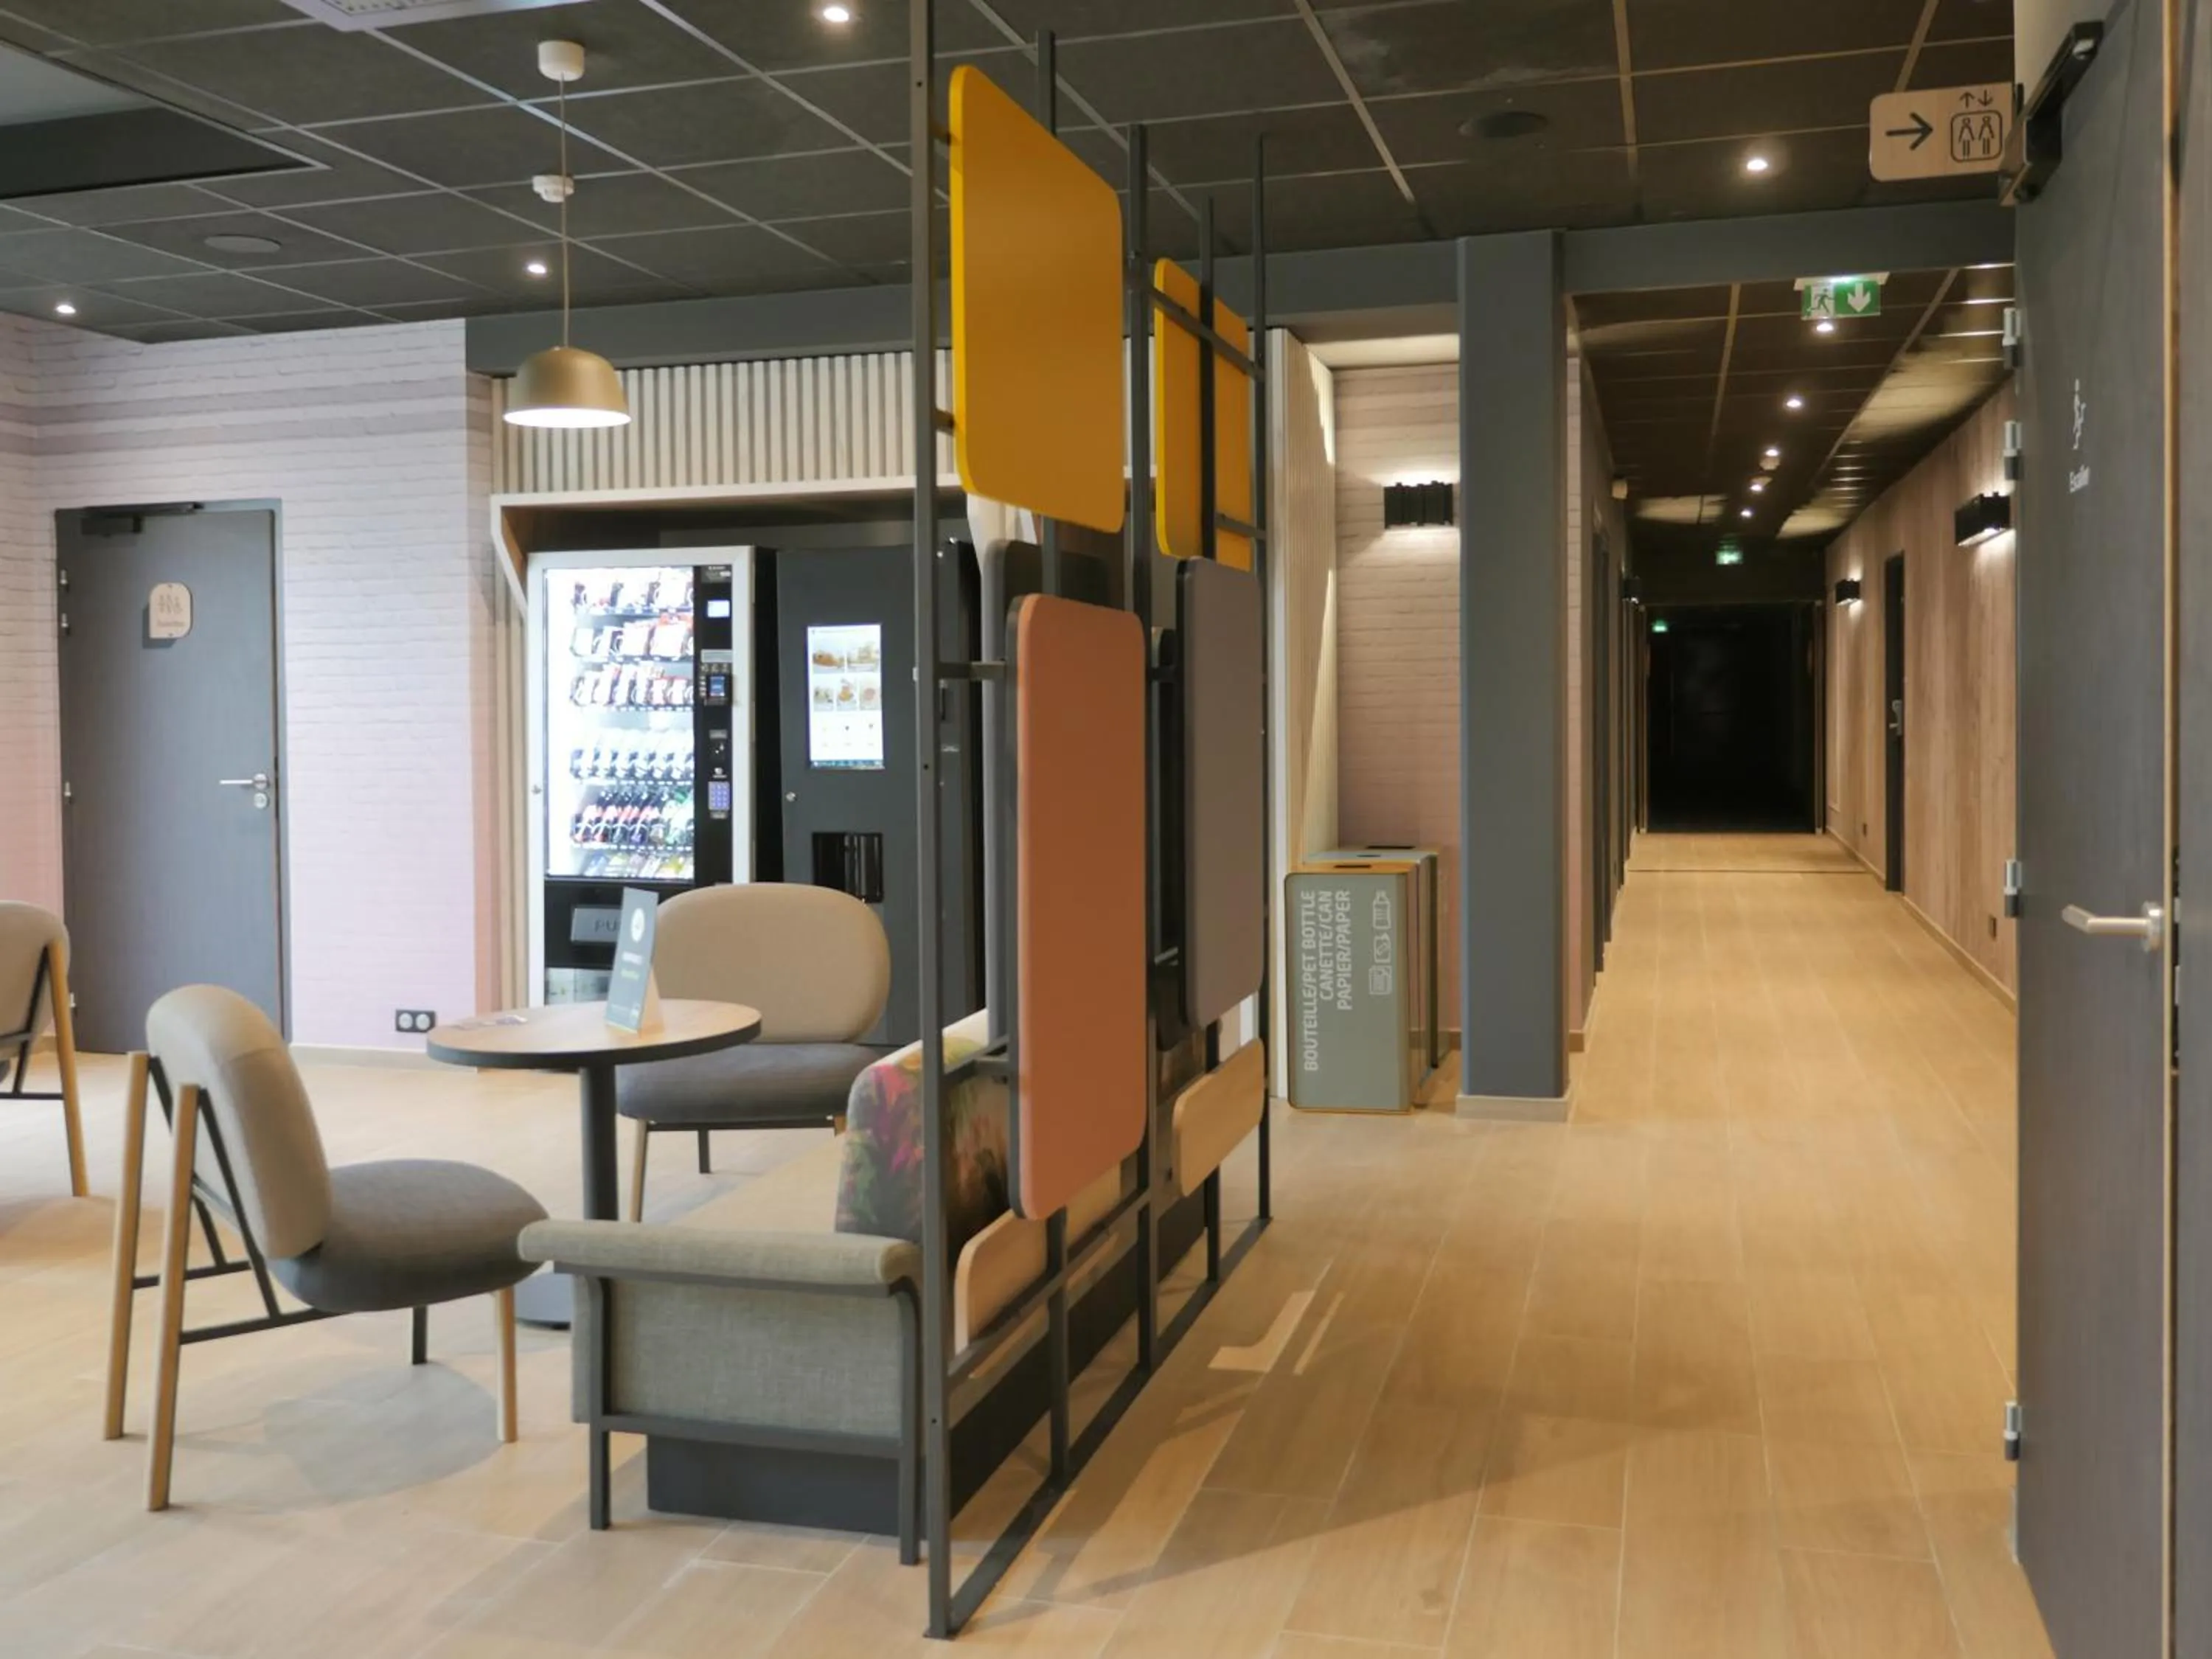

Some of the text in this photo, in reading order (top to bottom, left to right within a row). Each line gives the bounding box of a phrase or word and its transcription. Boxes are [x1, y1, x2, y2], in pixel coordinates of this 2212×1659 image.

[594, 918, 619, 933] PU
[1301, 890, 1319, 1071] BOUTEILLE/PET BOTTLE
[1318, 890, 1334, 1001] CANETTE/CAN
[1335, 890, 1352, 1010] PAPIER/PAPER
